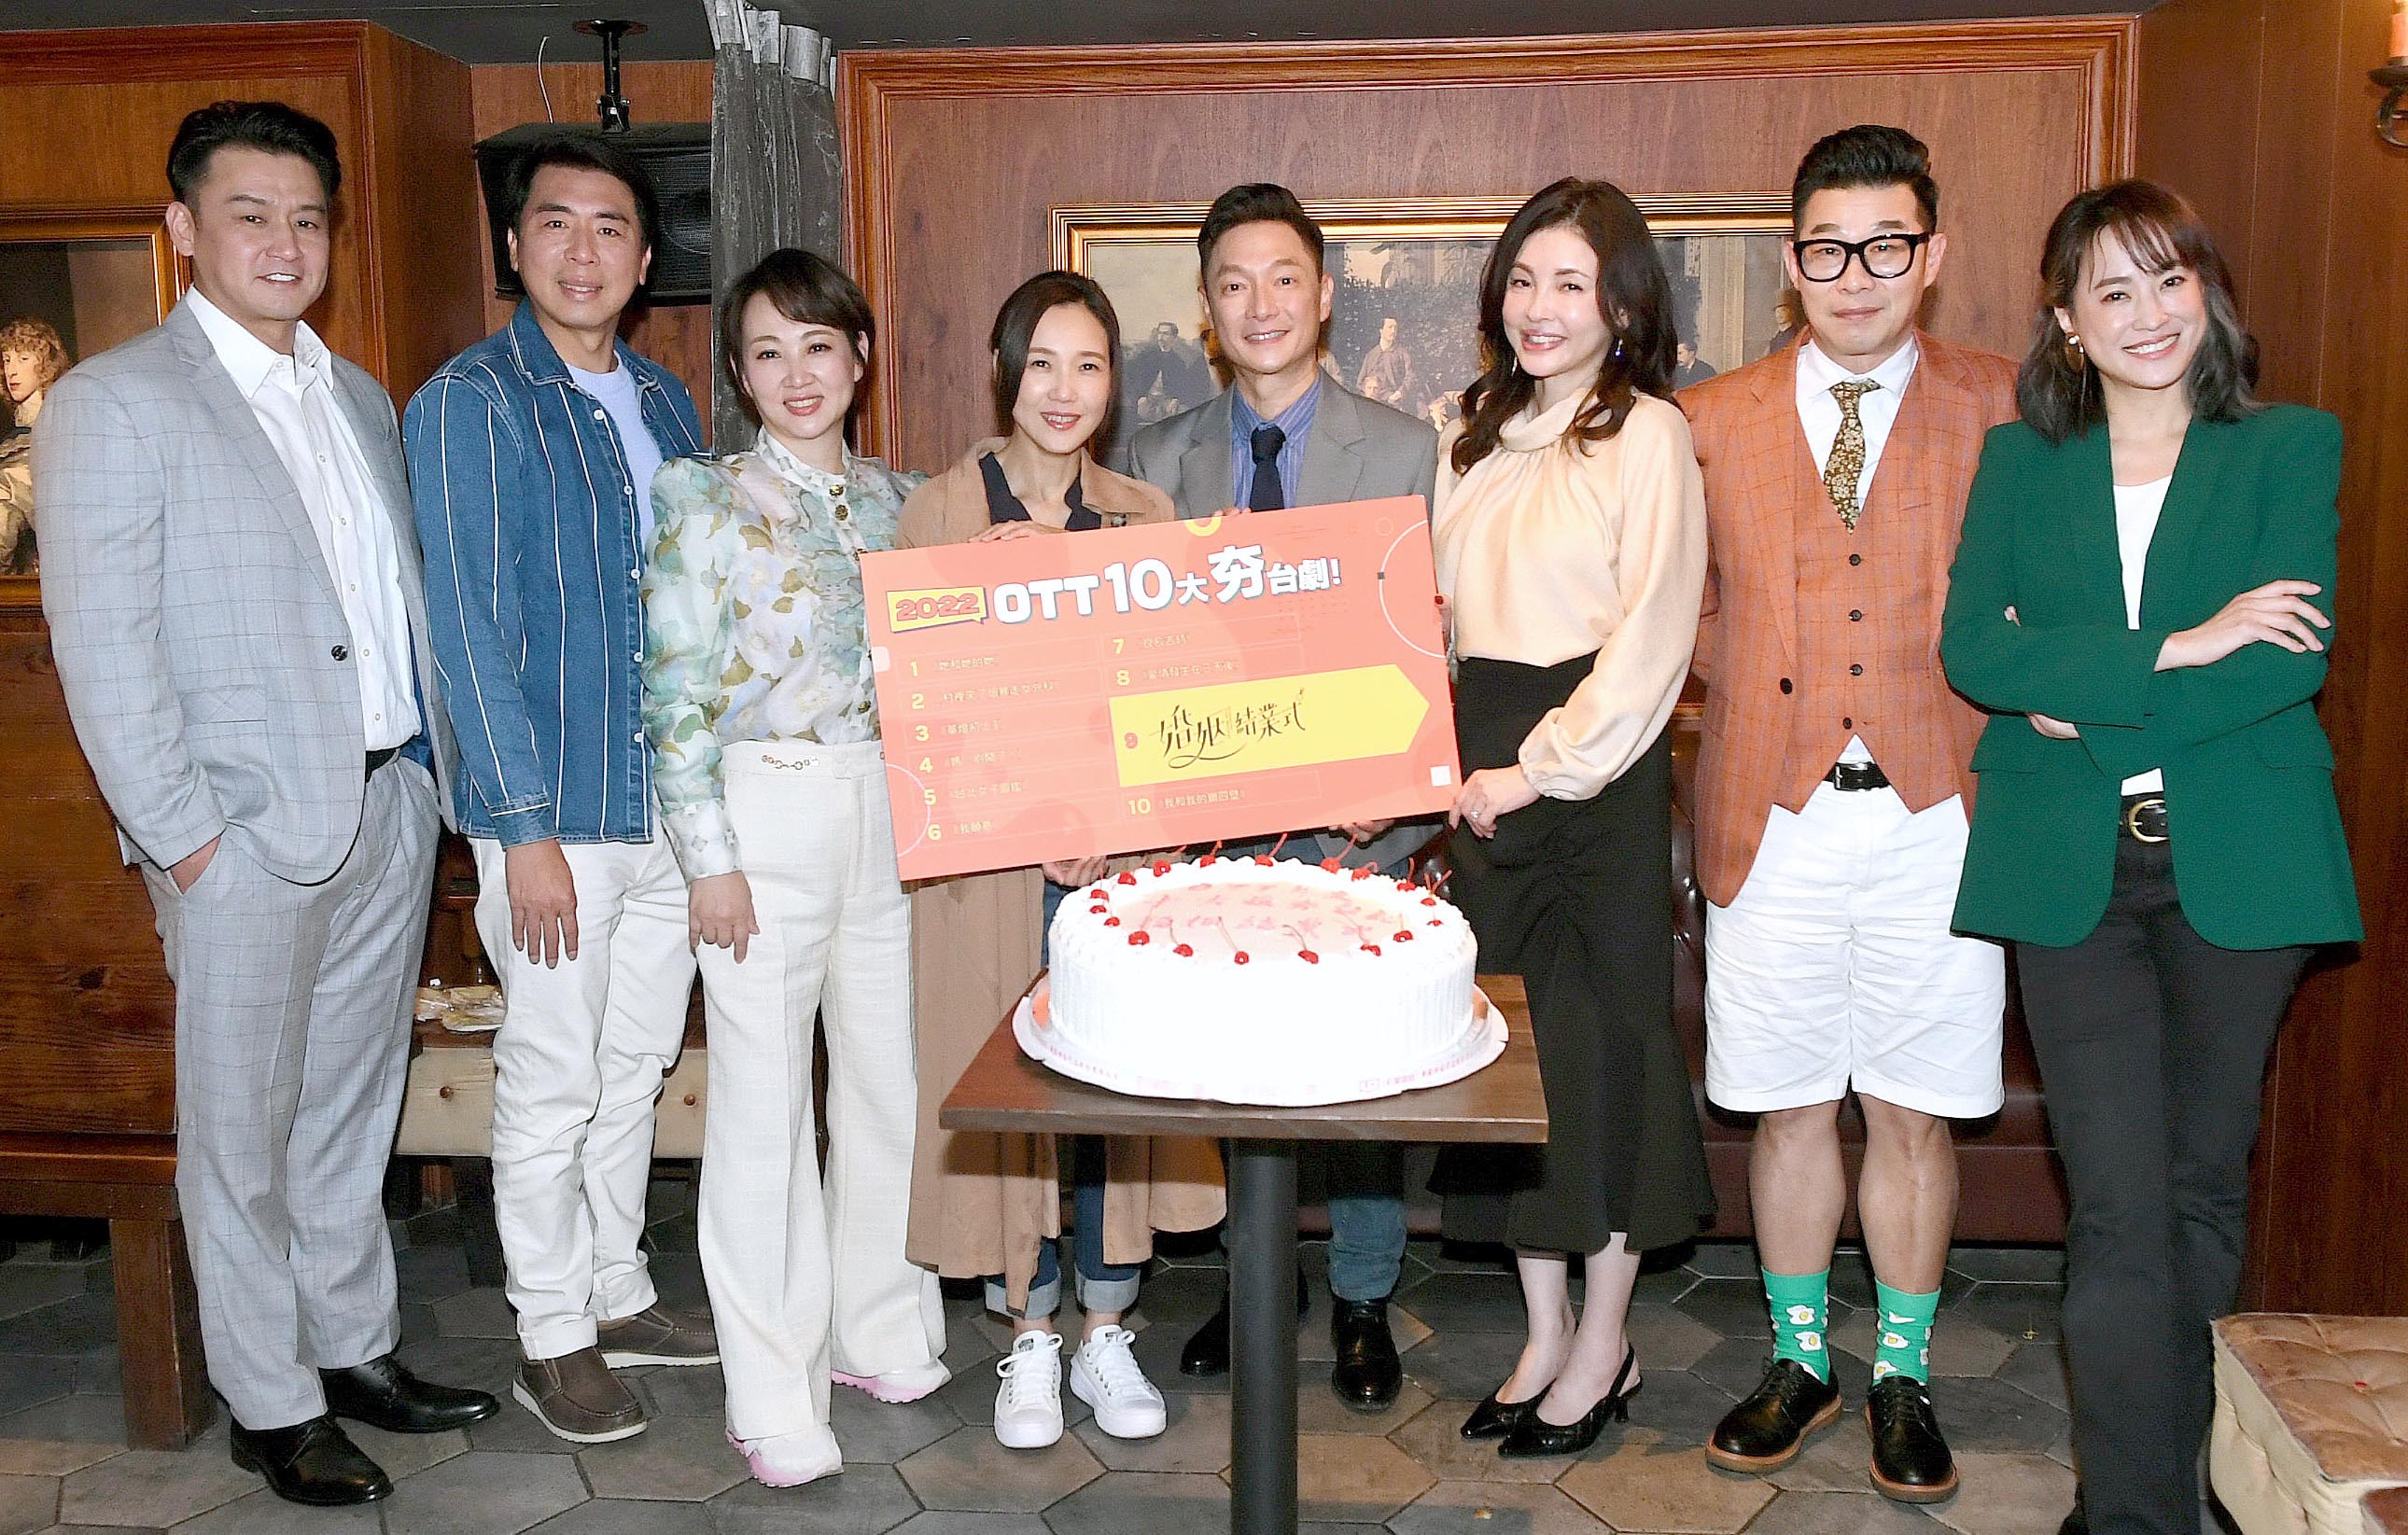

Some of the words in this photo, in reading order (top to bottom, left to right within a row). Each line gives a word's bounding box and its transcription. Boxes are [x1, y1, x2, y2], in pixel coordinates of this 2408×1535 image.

[895, 594, 980, 621] 2022
[1113, 638, 1125, 654] 7
[910, 661, 919, 677] 1
[1116, 670, 1130, 687] 8
[911, 693, 926, 710] 2
[915, 725, 930, 742] 3
[1125, 733, 1138, 748] 9
[918, 757, 934, 774] 4
[924, 788, 937, 805] 5
[1127, 798, 1152, 815] 10
[927, 824, 942, 841] 6
